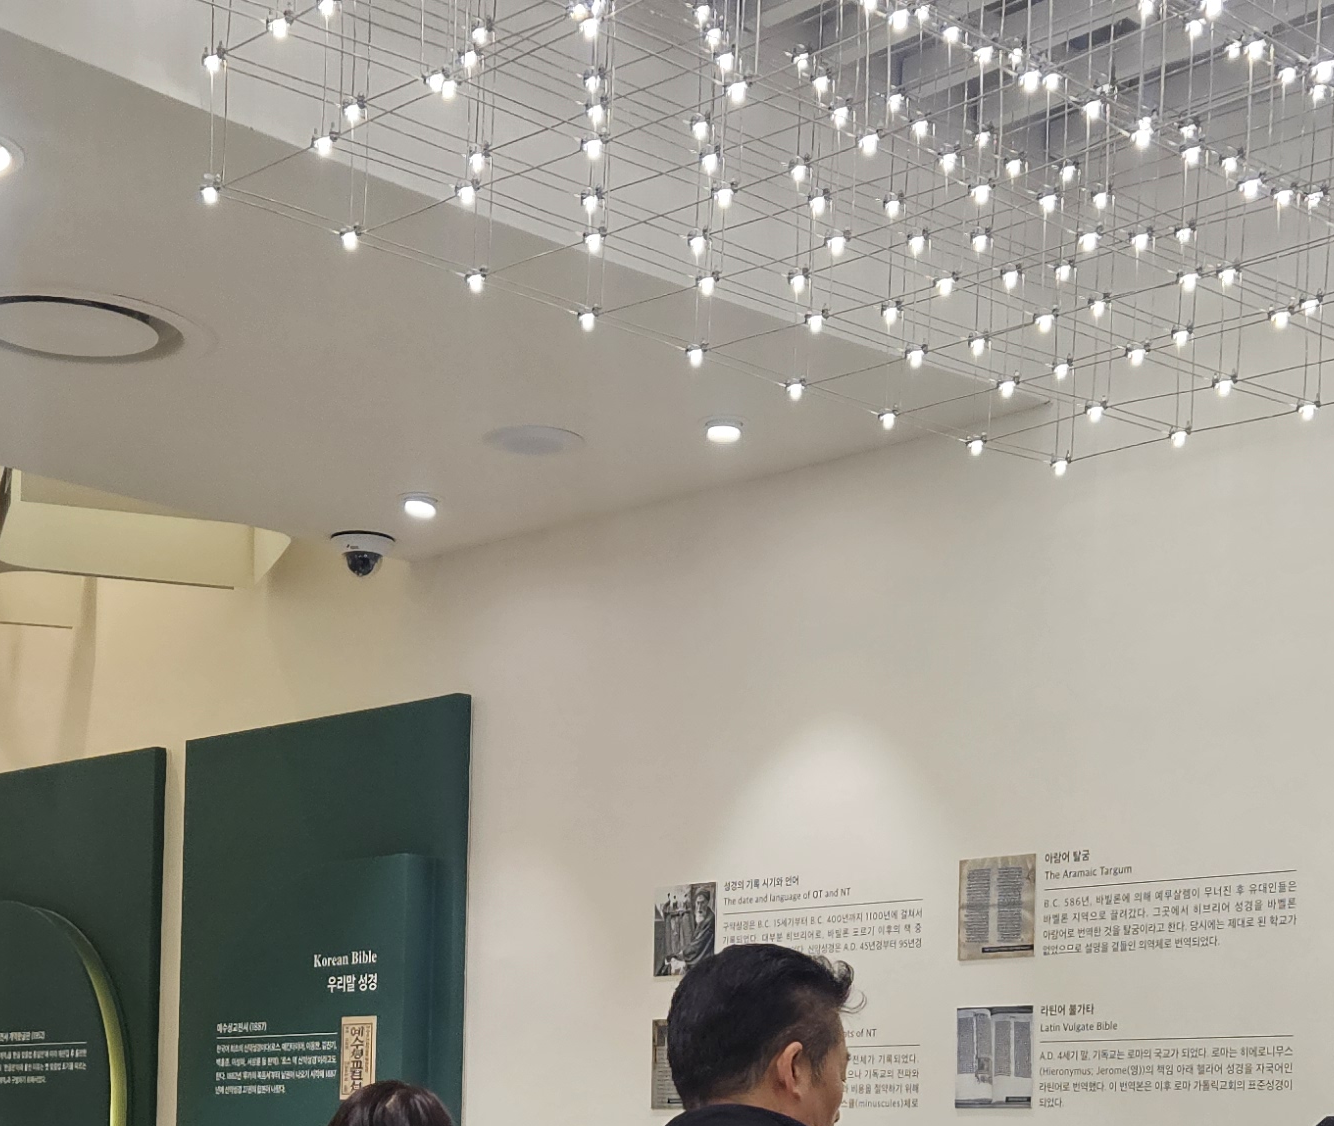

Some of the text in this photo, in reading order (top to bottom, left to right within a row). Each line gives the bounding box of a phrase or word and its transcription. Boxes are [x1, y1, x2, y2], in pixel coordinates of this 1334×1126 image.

[1044, 865, 1133, 881] The Aramaic Targum
[723, 875, 799, 892] 성경의 기록 시기와 언어
[723, 887, 851, 906] The date and language of OT and NT
[1064, 880, 1298, 908] 586년, 바빌론에 의해 예루살렘이 무너진 후 유대인들은
[1043, 912, 1069, 925] 바벨론
[1071, 910, 1107, 923] 지역으로
[1152, 904, 1189, 918] 그곳에서
[1193, 901, 1230, 915] 히브리어
[1234, 899, 1264, 913] 성경을
[1267, 897, 1297, 910] 바벨론
[1042, 914, 1297, 941] 아람어로 번역한 것을 한다. 당시에는 제대로 된 학교가
[313, 950, 377, 968] Korean Bible
[327, 973, 378, 993] 우리말 성경
[1040, 1004, 1066, 1017] 라틴어
[1040, 1020, 1118, 1033] Latin Vulgate Bible
[1056, 1050, 1079, 1061] 4세기
[1080, 1049, 1091, 1061] 말,
[1092, 1049, 1125, 1061] 기독교는
[1127, 1048, 1152, 1060] 로마의
[1153, 1047, 1180, 1060] 국교가
[1181, 1047, 1209, 1059] 되었다.
[1210, 1046, 1238, 1059] 로마는
[1240, 1045, 1294, 1058] 히에로니무스
[1156, 1064, 1174, 1076] 책임
[1176, 1063, 1194, 1076] 아래
[1225, 1062, 1253, 1075] 성경을
[1255, 1062, 1293, 1075] 자국어인
[1038, 1079, 1293, 1093] 라틴어로 번역했다. 이 번역본은 이후 로마 가톨릭교회의 표준성경이
